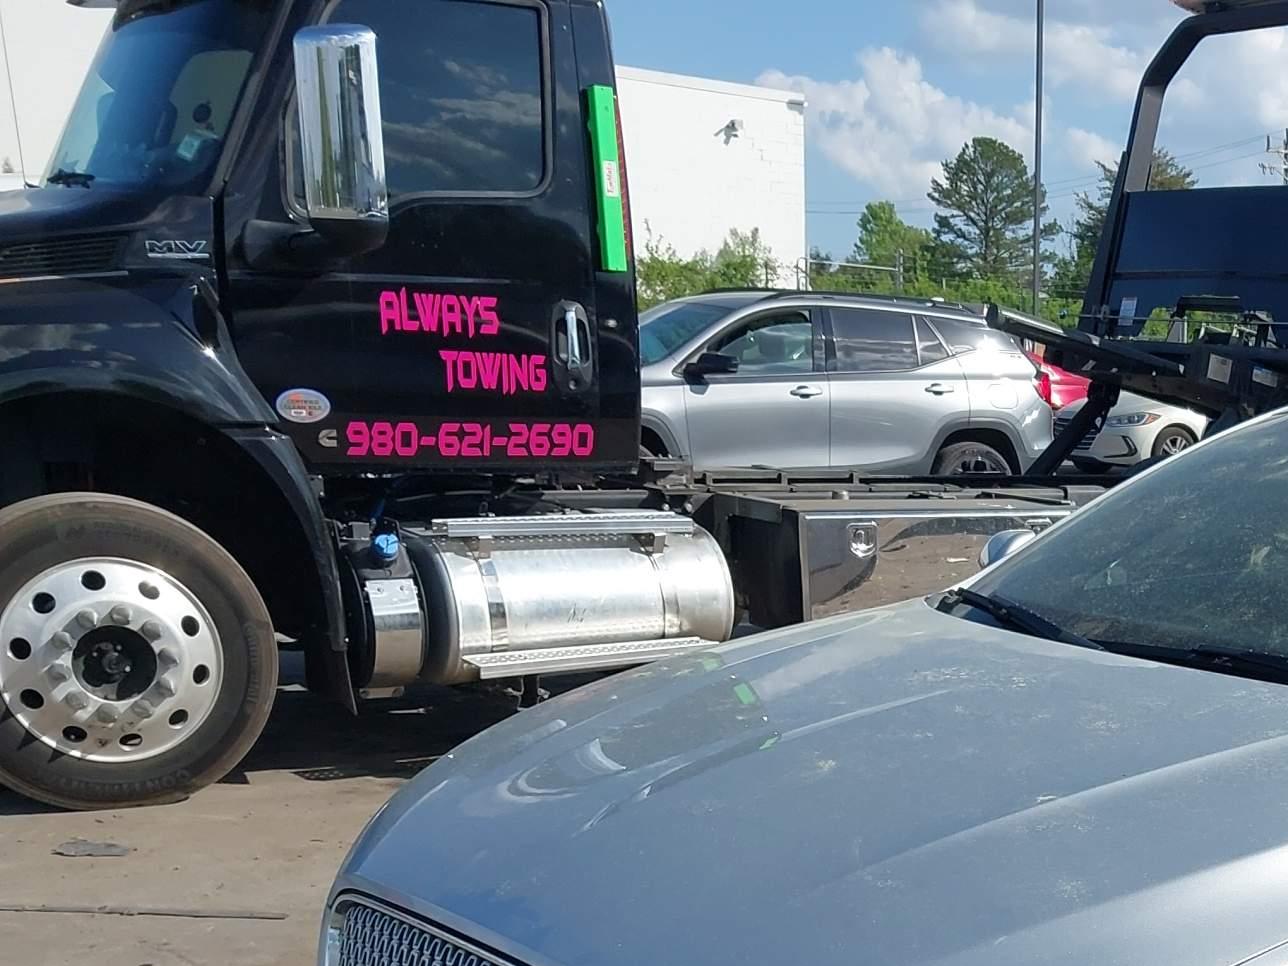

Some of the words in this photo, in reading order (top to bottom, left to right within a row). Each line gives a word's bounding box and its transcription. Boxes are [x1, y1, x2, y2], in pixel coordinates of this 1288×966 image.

[145, 240, 207, 254] MV
[379, 287, 500, 338] ALWAYS
[438, 350, 547, 394] TOWING
[346, 421, 594, 456] 980-621-2690
